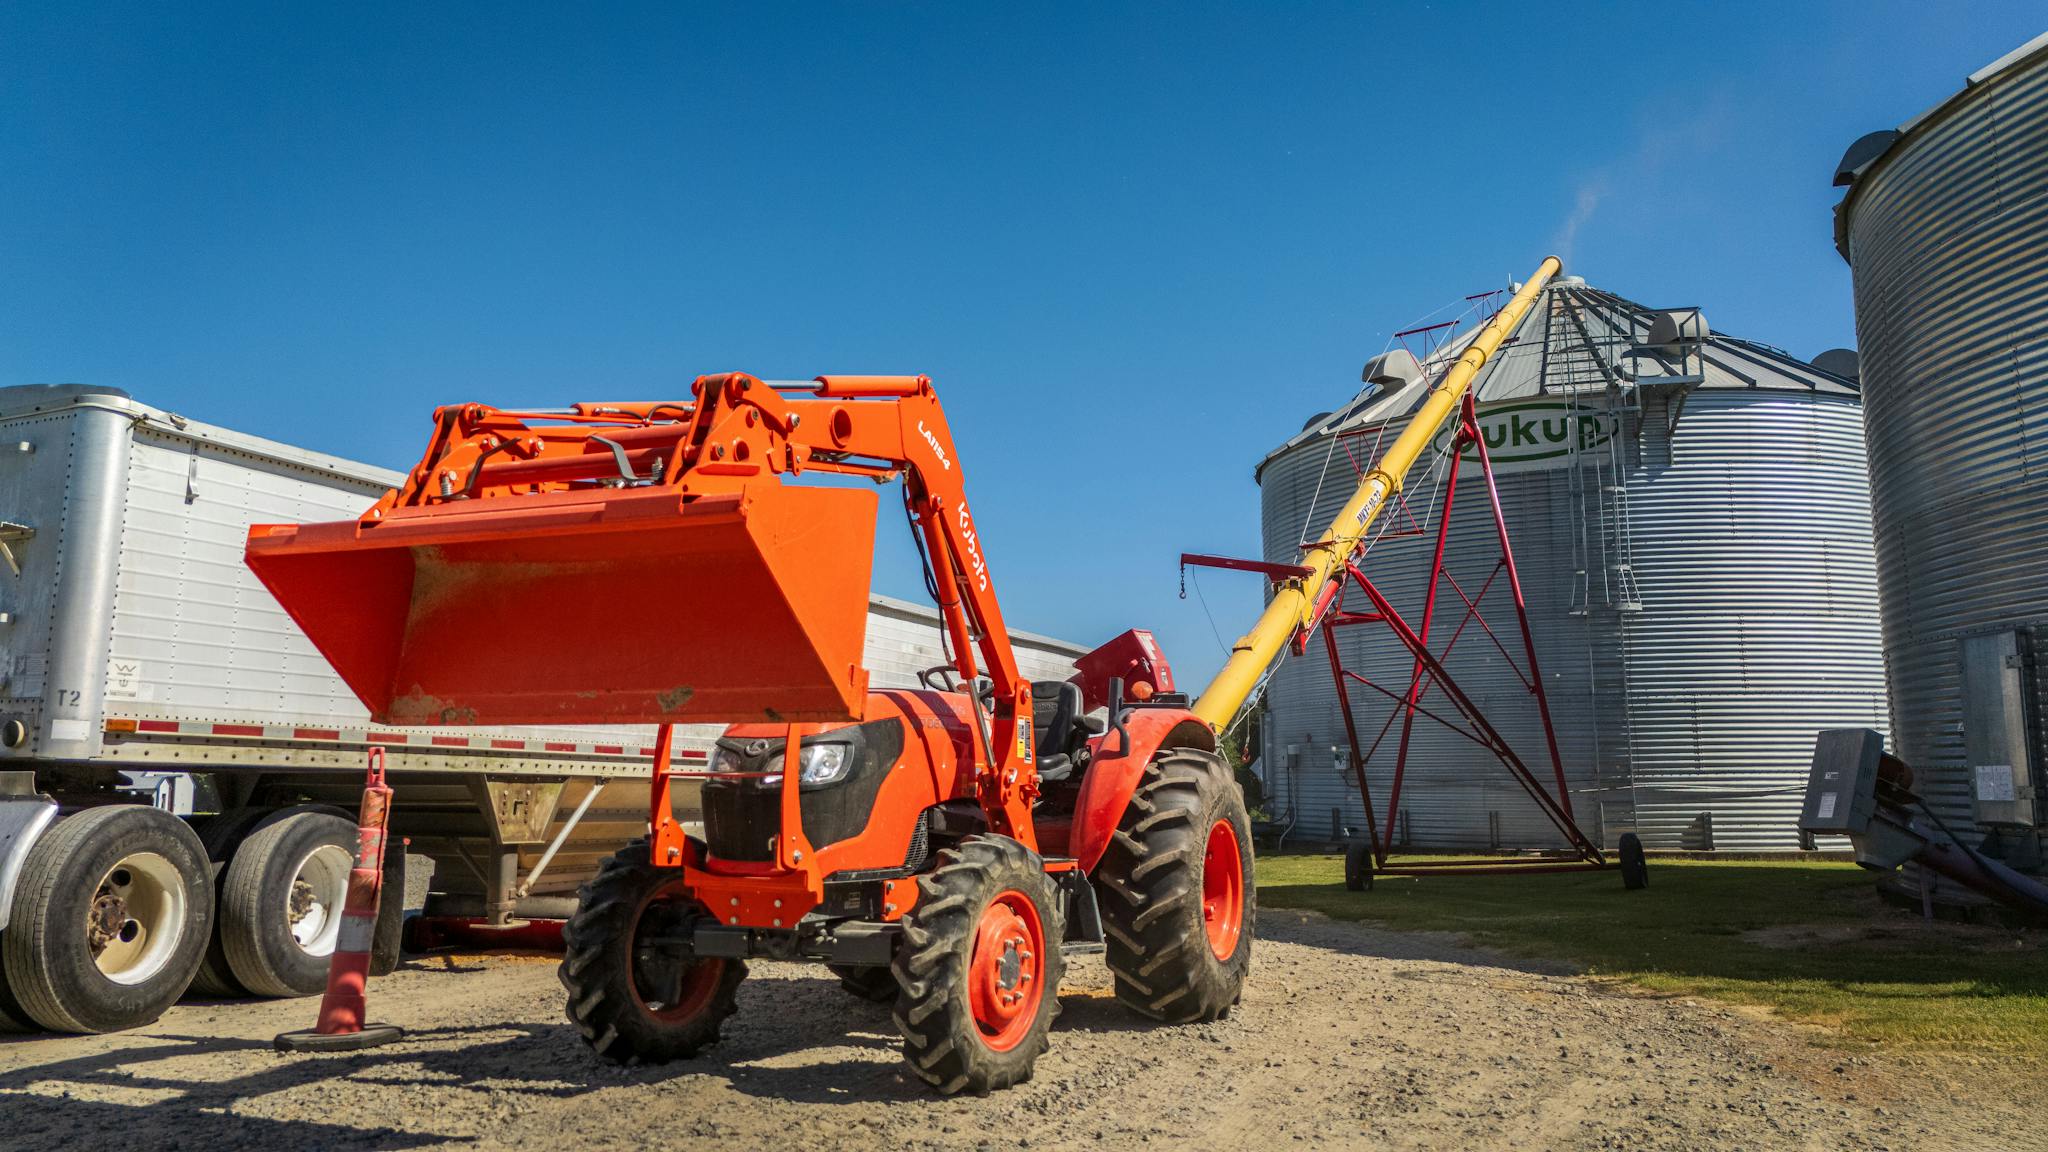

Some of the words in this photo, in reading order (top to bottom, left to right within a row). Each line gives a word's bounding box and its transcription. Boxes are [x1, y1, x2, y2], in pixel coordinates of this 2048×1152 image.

[918, 420, 951, 471] LA1154
[958, 501, 987, 593] Kubota
[57, 689, 81, 707] T2
